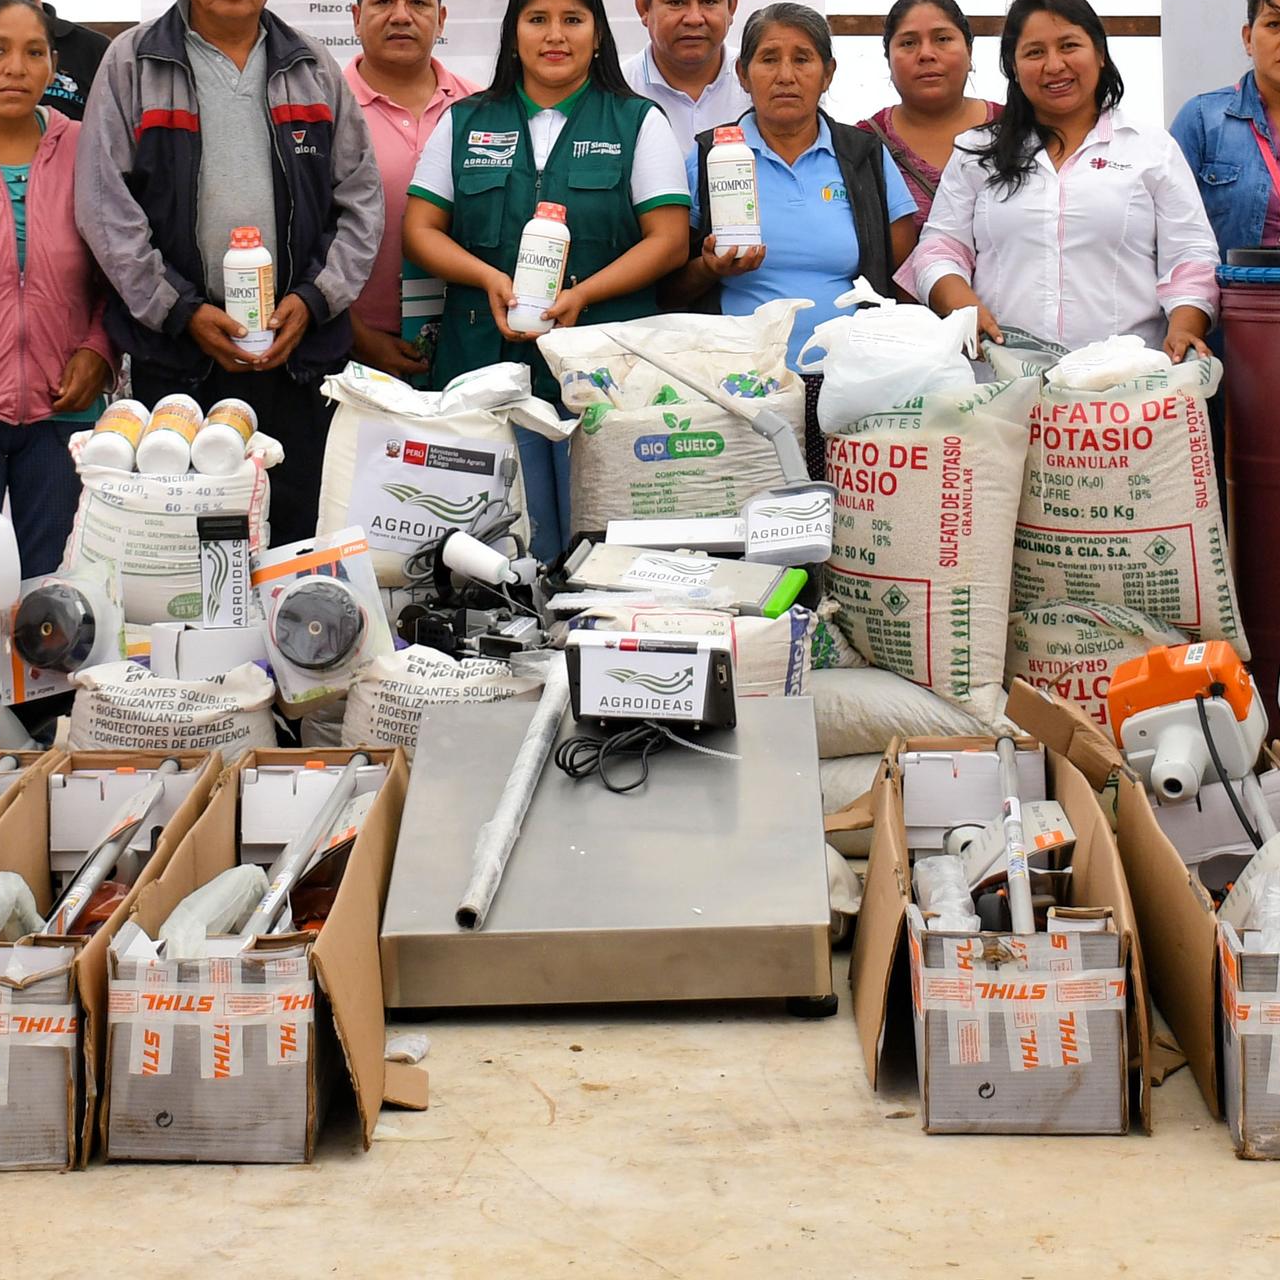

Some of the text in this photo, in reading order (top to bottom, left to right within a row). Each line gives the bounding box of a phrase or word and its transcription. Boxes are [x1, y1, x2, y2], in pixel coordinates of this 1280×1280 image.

[309, 2, 342, 14] Plazo
[464, 157, 514, 166] AGROIDEAS
[1142, 396, 1178, 422] DE
[1029, 423, 1153, 452] POTASIO
[405, 447, 424, 458] PERÚ
[430, 447, 460, 458] Ministerio
[640, 438, 718, 456] BIO SUELO
[437, 455, 466, 465] Desarrollo
[890, 445, 928, 470] DE
[1046, 454, 1129, 469] GRANULAR
[1030, 470, 1150, 486] POTASIO 50%
[1191, 456, 1208, 509] SULFATO
[168, 488, 212, 496] 35 40
[1029, 488, 1152, 501] AZUFRE 18%
[165, 503, 210, 512] 60 65
[939, 436, 962, 568] SULFATO DE POTASIO
[962, 468, 973, 536] GRANULAR
[1044, 502, 1135, 520] Peso: 50 Kg
[750, 523, 832, 541] AGROIDEAS
[872, 519, 893, 532] 50%
[872, 534, 892, 547] 18%
[1054, 534, 1108, 545] IMPORTADO
[343, 543, 366, 555] STIHL
[844, 545, 876, 565] 50 Kg
[1078, 546, 1131, 558] CIA. S.A.
[1057, 560, 1088, 570] Central
[232, 540, 243, 626] AGROIDEAS
[630, 569, 708, 586] AGROIDEAS
[1042, 614, 1057, 626] 50
[1075, 638, 1124, 654] POTASIO
[406, 663, 428, 678] EN
[600, 696, 694, 712] AGROIDEAS
[96, 704, 194, 724] BIOESTIMULANTES
[96, 718, 234, 737] PROTECTORES VEGETALES
[94, 726, 250, 749] CORRECTORES DE DEFICIENCIA
[975, 982, 1048, 1001] STIHL
[141, 994, 216, 1012] STIHL
